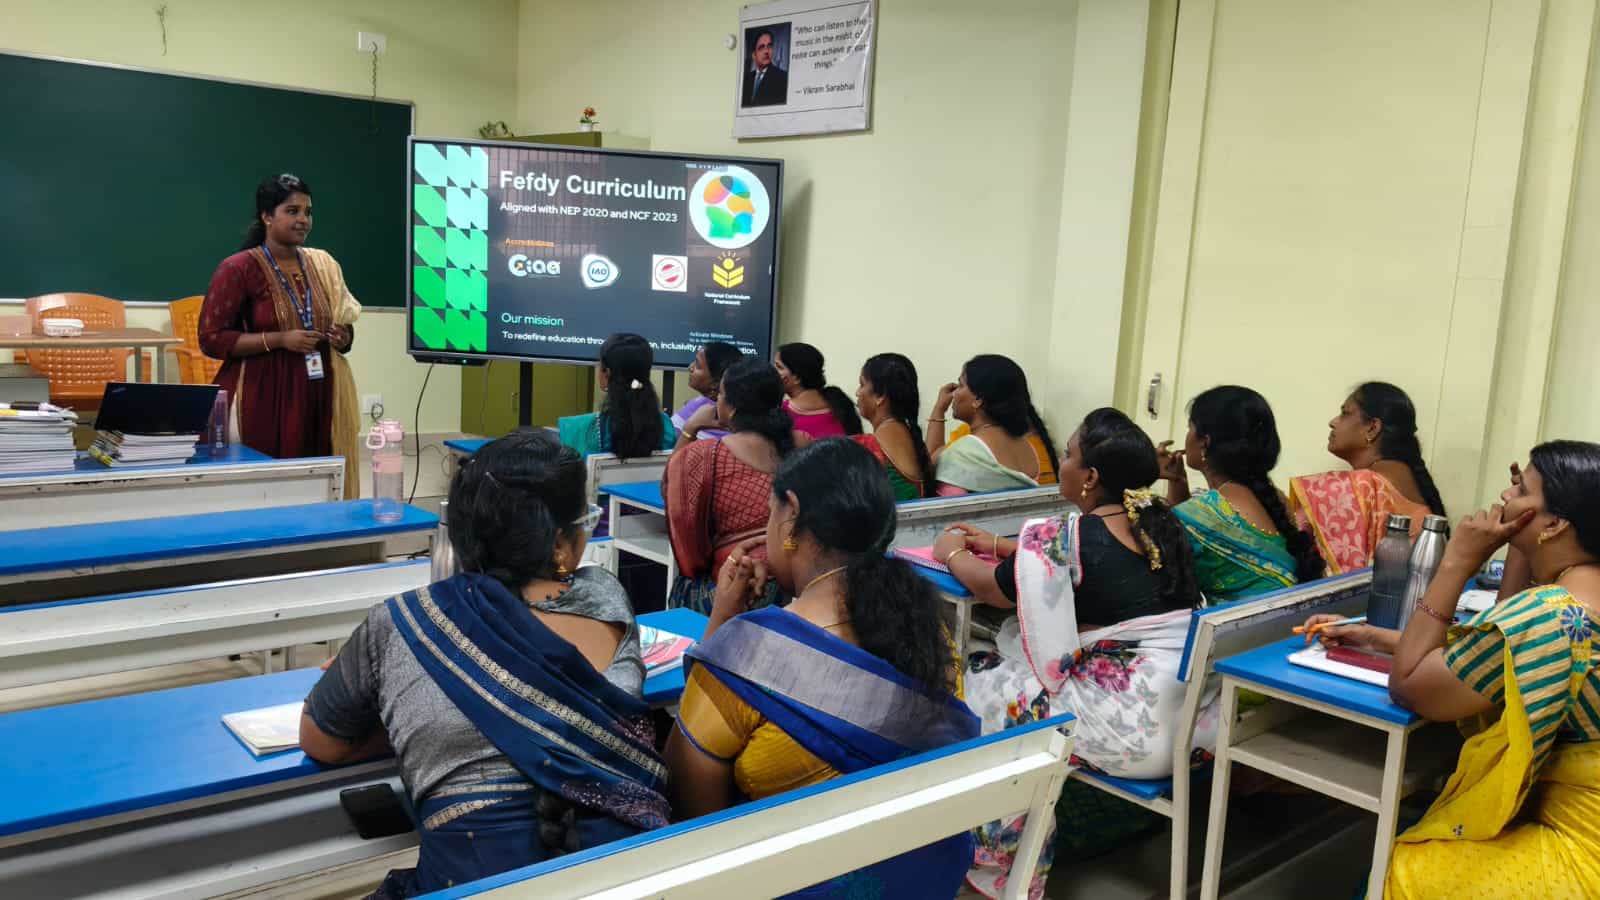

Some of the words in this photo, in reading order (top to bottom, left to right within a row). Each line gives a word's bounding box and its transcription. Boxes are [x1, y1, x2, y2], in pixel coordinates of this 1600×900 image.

[814, 23, 825, 32] can
[826, 20, 844, 30] listen
[816, 36, 821, 44] in
[823, 34, 834, 42] the
[809, 48, 820, 57] can
[821, 46, 845, 56] achieve
[826, 82, 855, 93] Sarabhai
[500, 170, 560, 197] Fefdy
[566, 174, 686, 200] Curriculum
[500, 201, 537, 214] Aligned
[538, 204, 558, 214] with
[560, 206, 581, 216] NEP
[582, 207, 608, 217] 2020
[610, 209, 628, 219] and
[629, 210, 650, 220] NCF
[652, 212, 678, 223] 2023
[501, 312, 522, 324] Our
[524, 313, 564, 326] mission
[502, 330, 513, 339] To
[514, 332, 546, 342] redefine
[548, 333, 585, 345] education
[587, 335, 605, 345] thro
[660, 340, 696, 353] inclusivity
